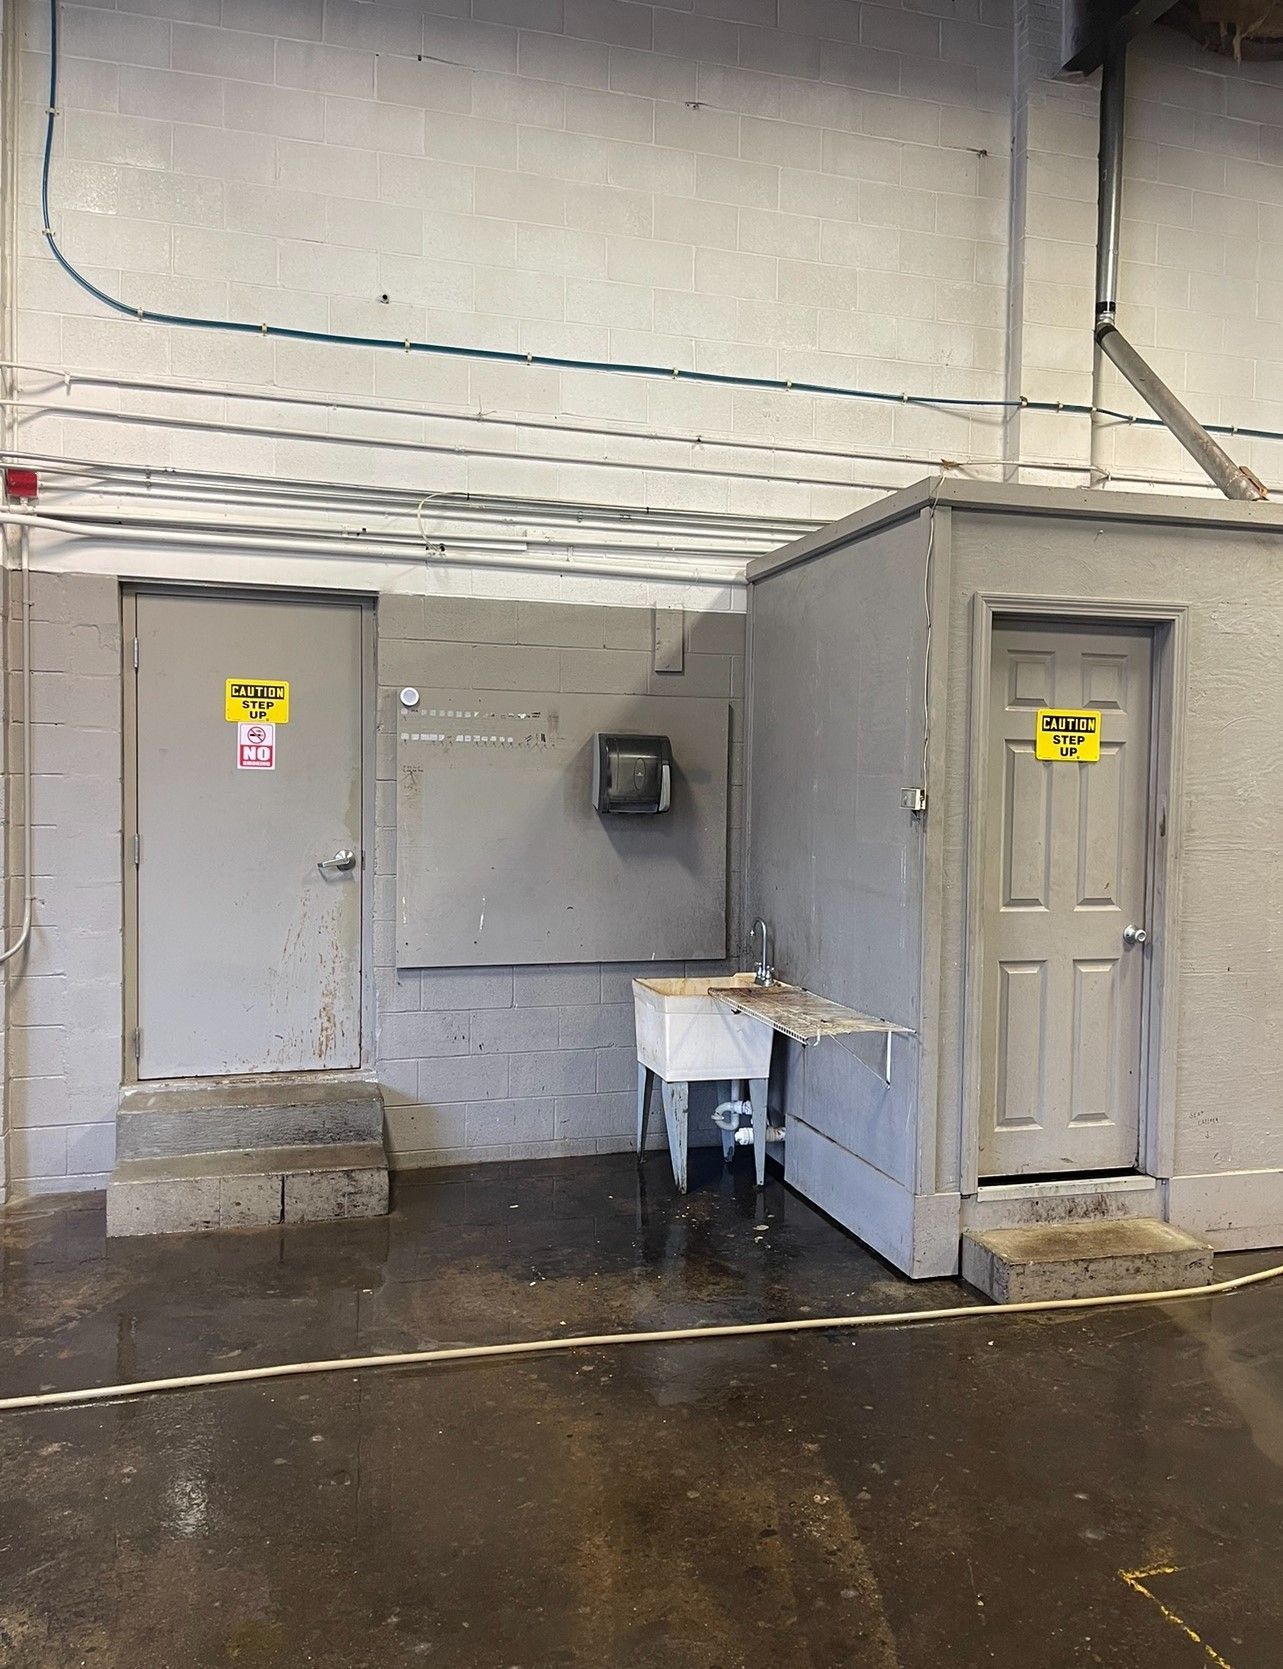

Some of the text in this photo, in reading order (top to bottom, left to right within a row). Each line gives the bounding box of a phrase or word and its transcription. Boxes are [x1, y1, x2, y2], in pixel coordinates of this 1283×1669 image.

[232, 685, 284, 698] CAUTION
[242, 700, 274, 709] STEP
[249, 711, 267, 719] UP
[1043, 717, 1095, 731] CAUTION
[1053, 735, 1085, 745] STEP
[243, 745, 271, 761] NO
[1060, 747, 1078, 756] UP
